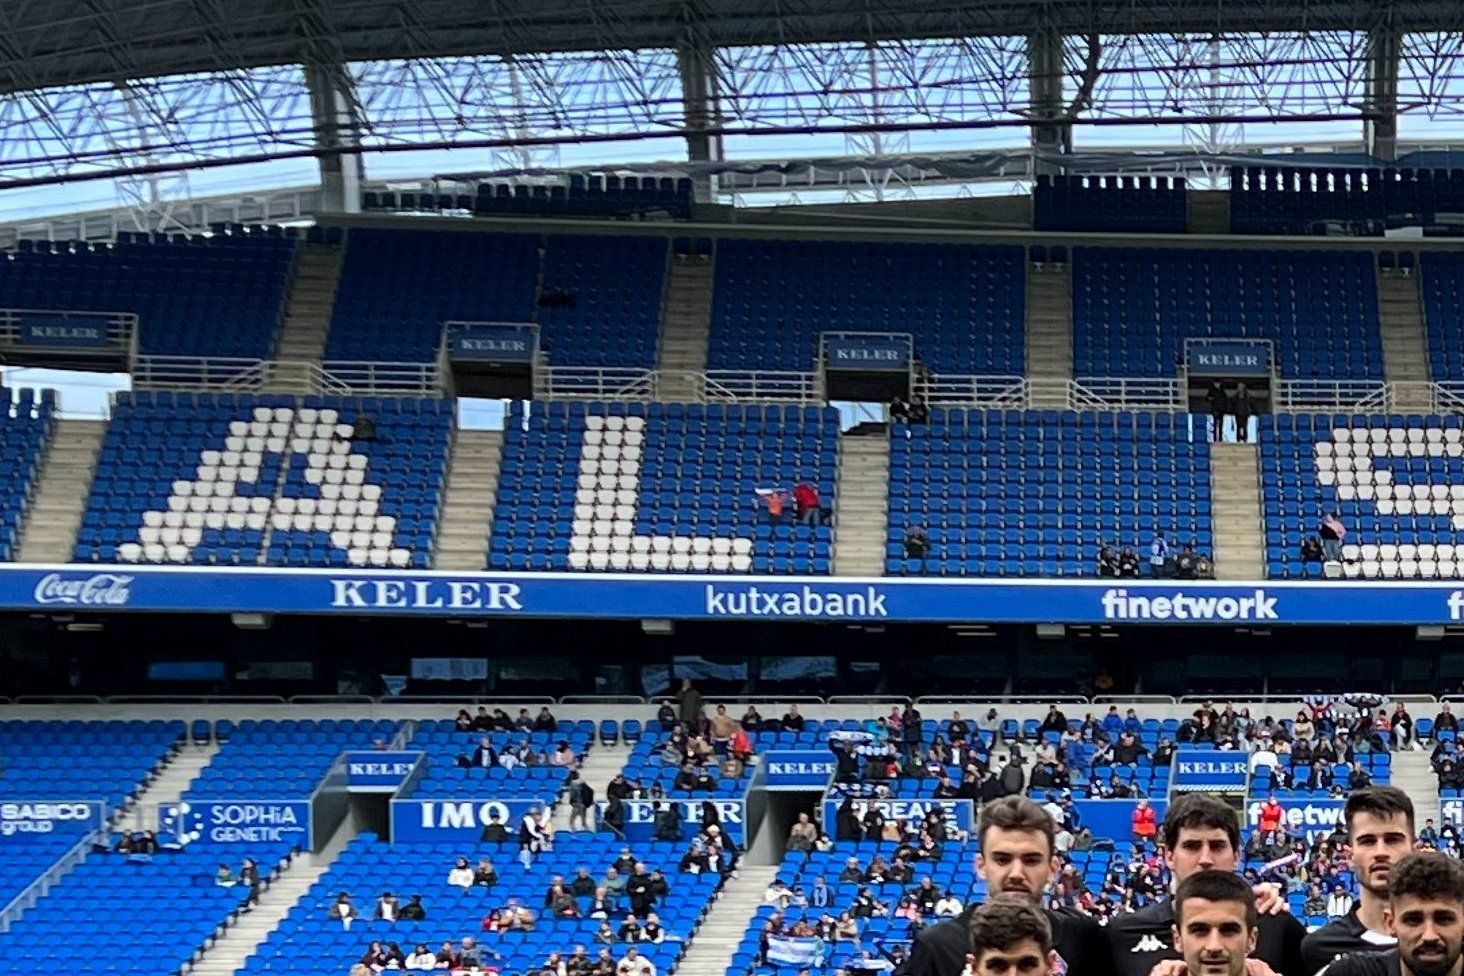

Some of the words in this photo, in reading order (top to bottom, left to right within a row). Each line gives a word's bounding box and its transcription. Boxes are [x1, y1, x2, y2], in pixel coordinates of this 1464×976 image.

[31, 325, 98, 340] KELER
[461, 338, 525, 352] KELER
[836, 348, 898, 361] KELER
[1198, 353, 1258, 367] KELER
[330, 579, 522, 611] KELER
[705, 584, 888, 617] kutxabank
[1101, 589, 1278, 621] finetwork
[349, 763, 414, 776] KELE
[1178, 762, 1247, 774] KELER
[0, 804, 91, 820] SABICO
[210, 827, 295, 842] GENETIC
